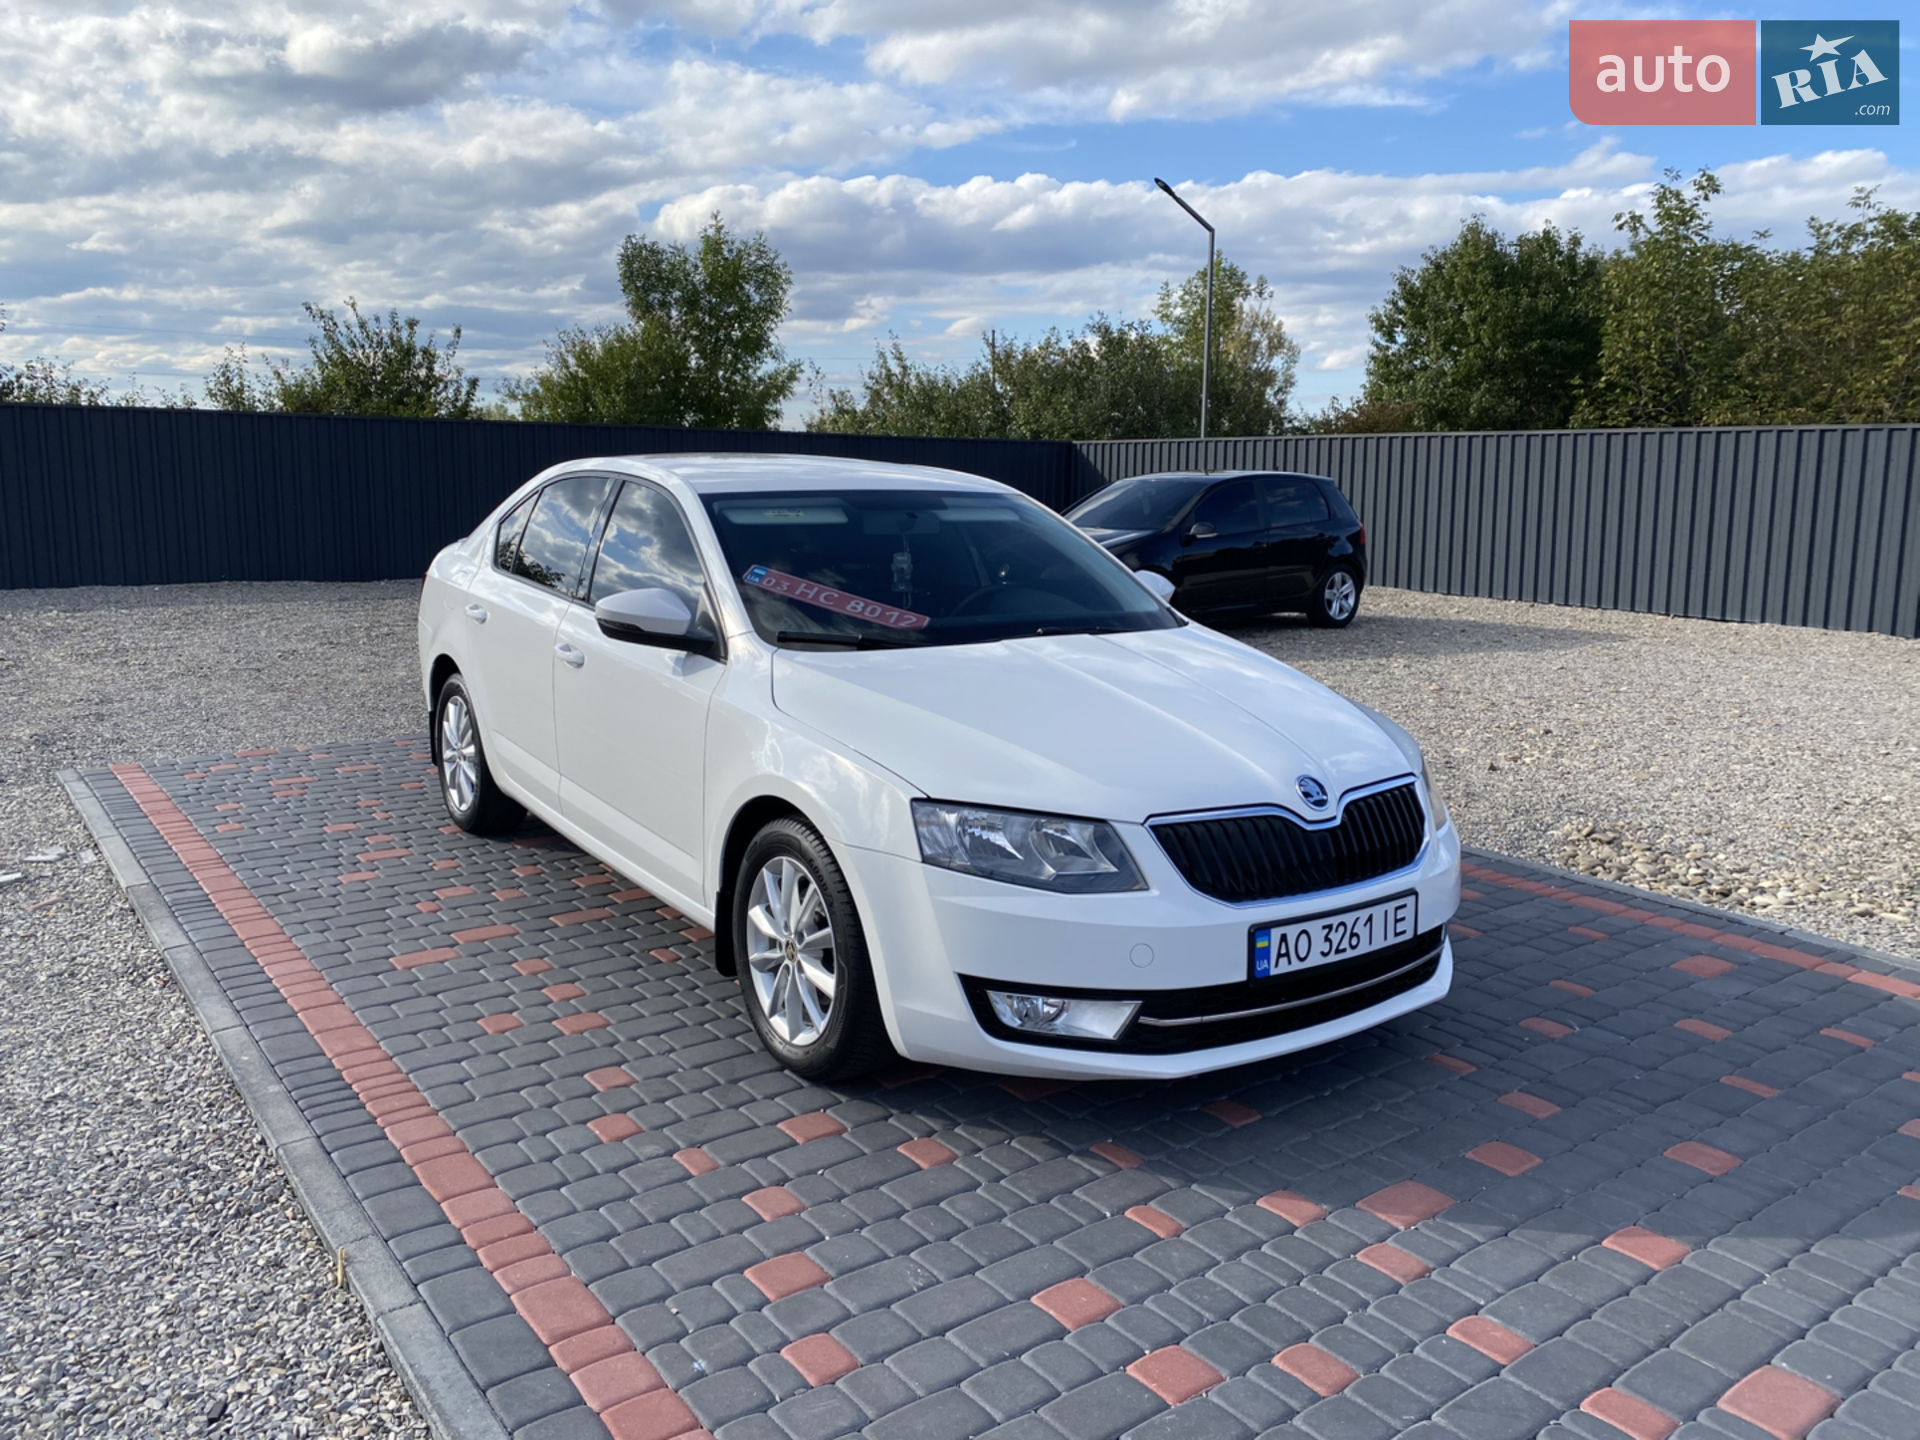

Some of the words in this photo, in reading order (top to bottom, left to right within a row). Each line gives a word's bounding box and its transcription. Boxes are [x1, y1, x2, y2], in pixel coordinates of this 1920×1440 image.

[762, 576, 791, 592] 03
[795, 583, 839, 606] HC
[845, 600, 917, 629] 8012
[1274, 929, 1312, 968] AO
[1320, 913, 1373, 957] 3261
[1384, 903, 1408, 941] IE
[1256, 959, 1269, 971] UA
